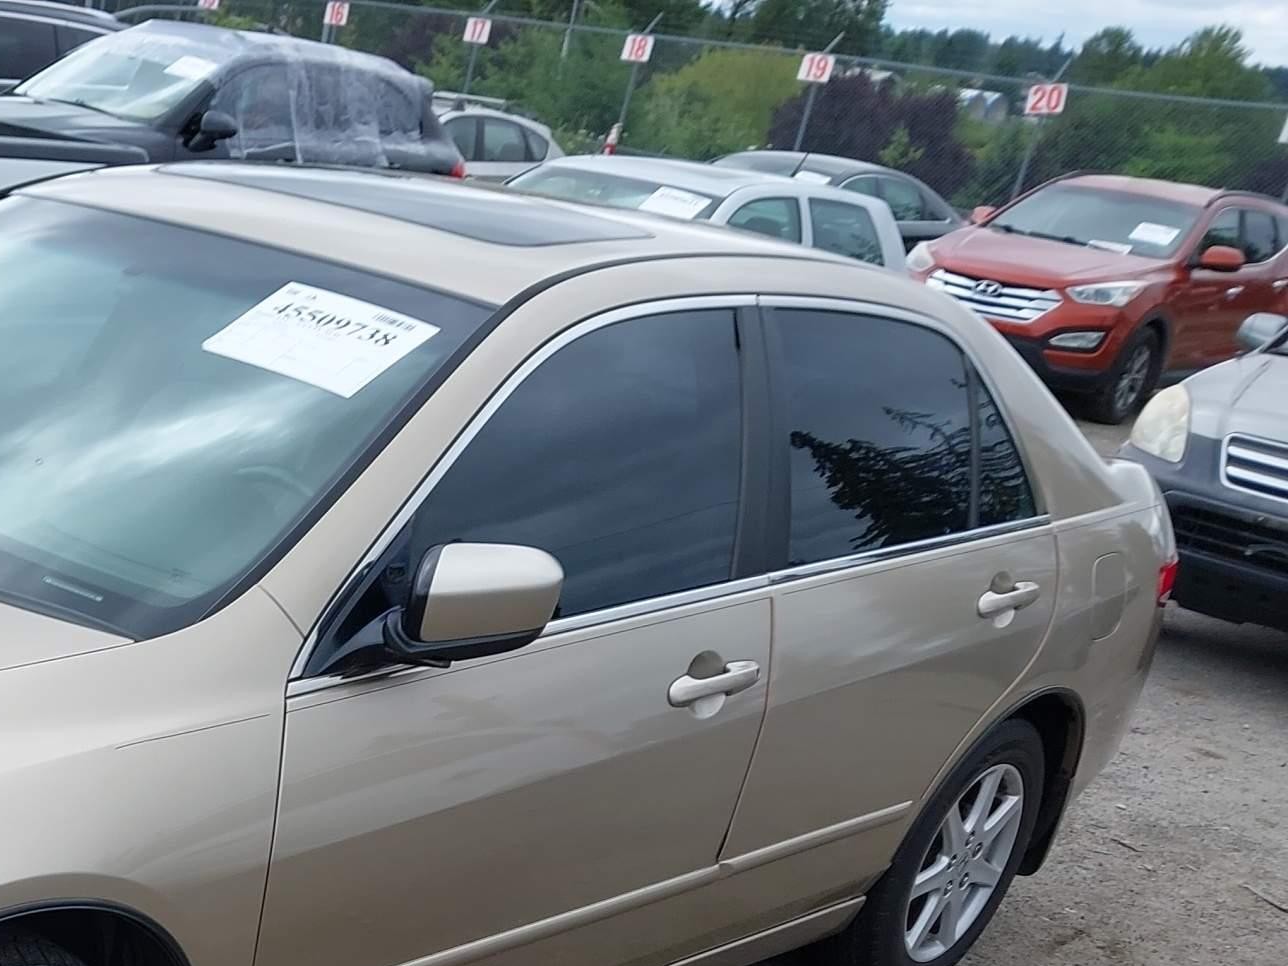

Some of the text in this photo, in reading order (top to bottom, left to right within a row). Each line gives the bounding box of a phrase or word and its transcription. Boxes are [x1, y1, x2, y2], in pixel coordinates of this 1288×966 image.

[470, 18, 487, 41] 17
[628, 37, 649, 59] 18
[806, 56, 829, 80] 19
[1029, 86, 1064, 112] 20
[273, 302, 397, 346] 45509738
